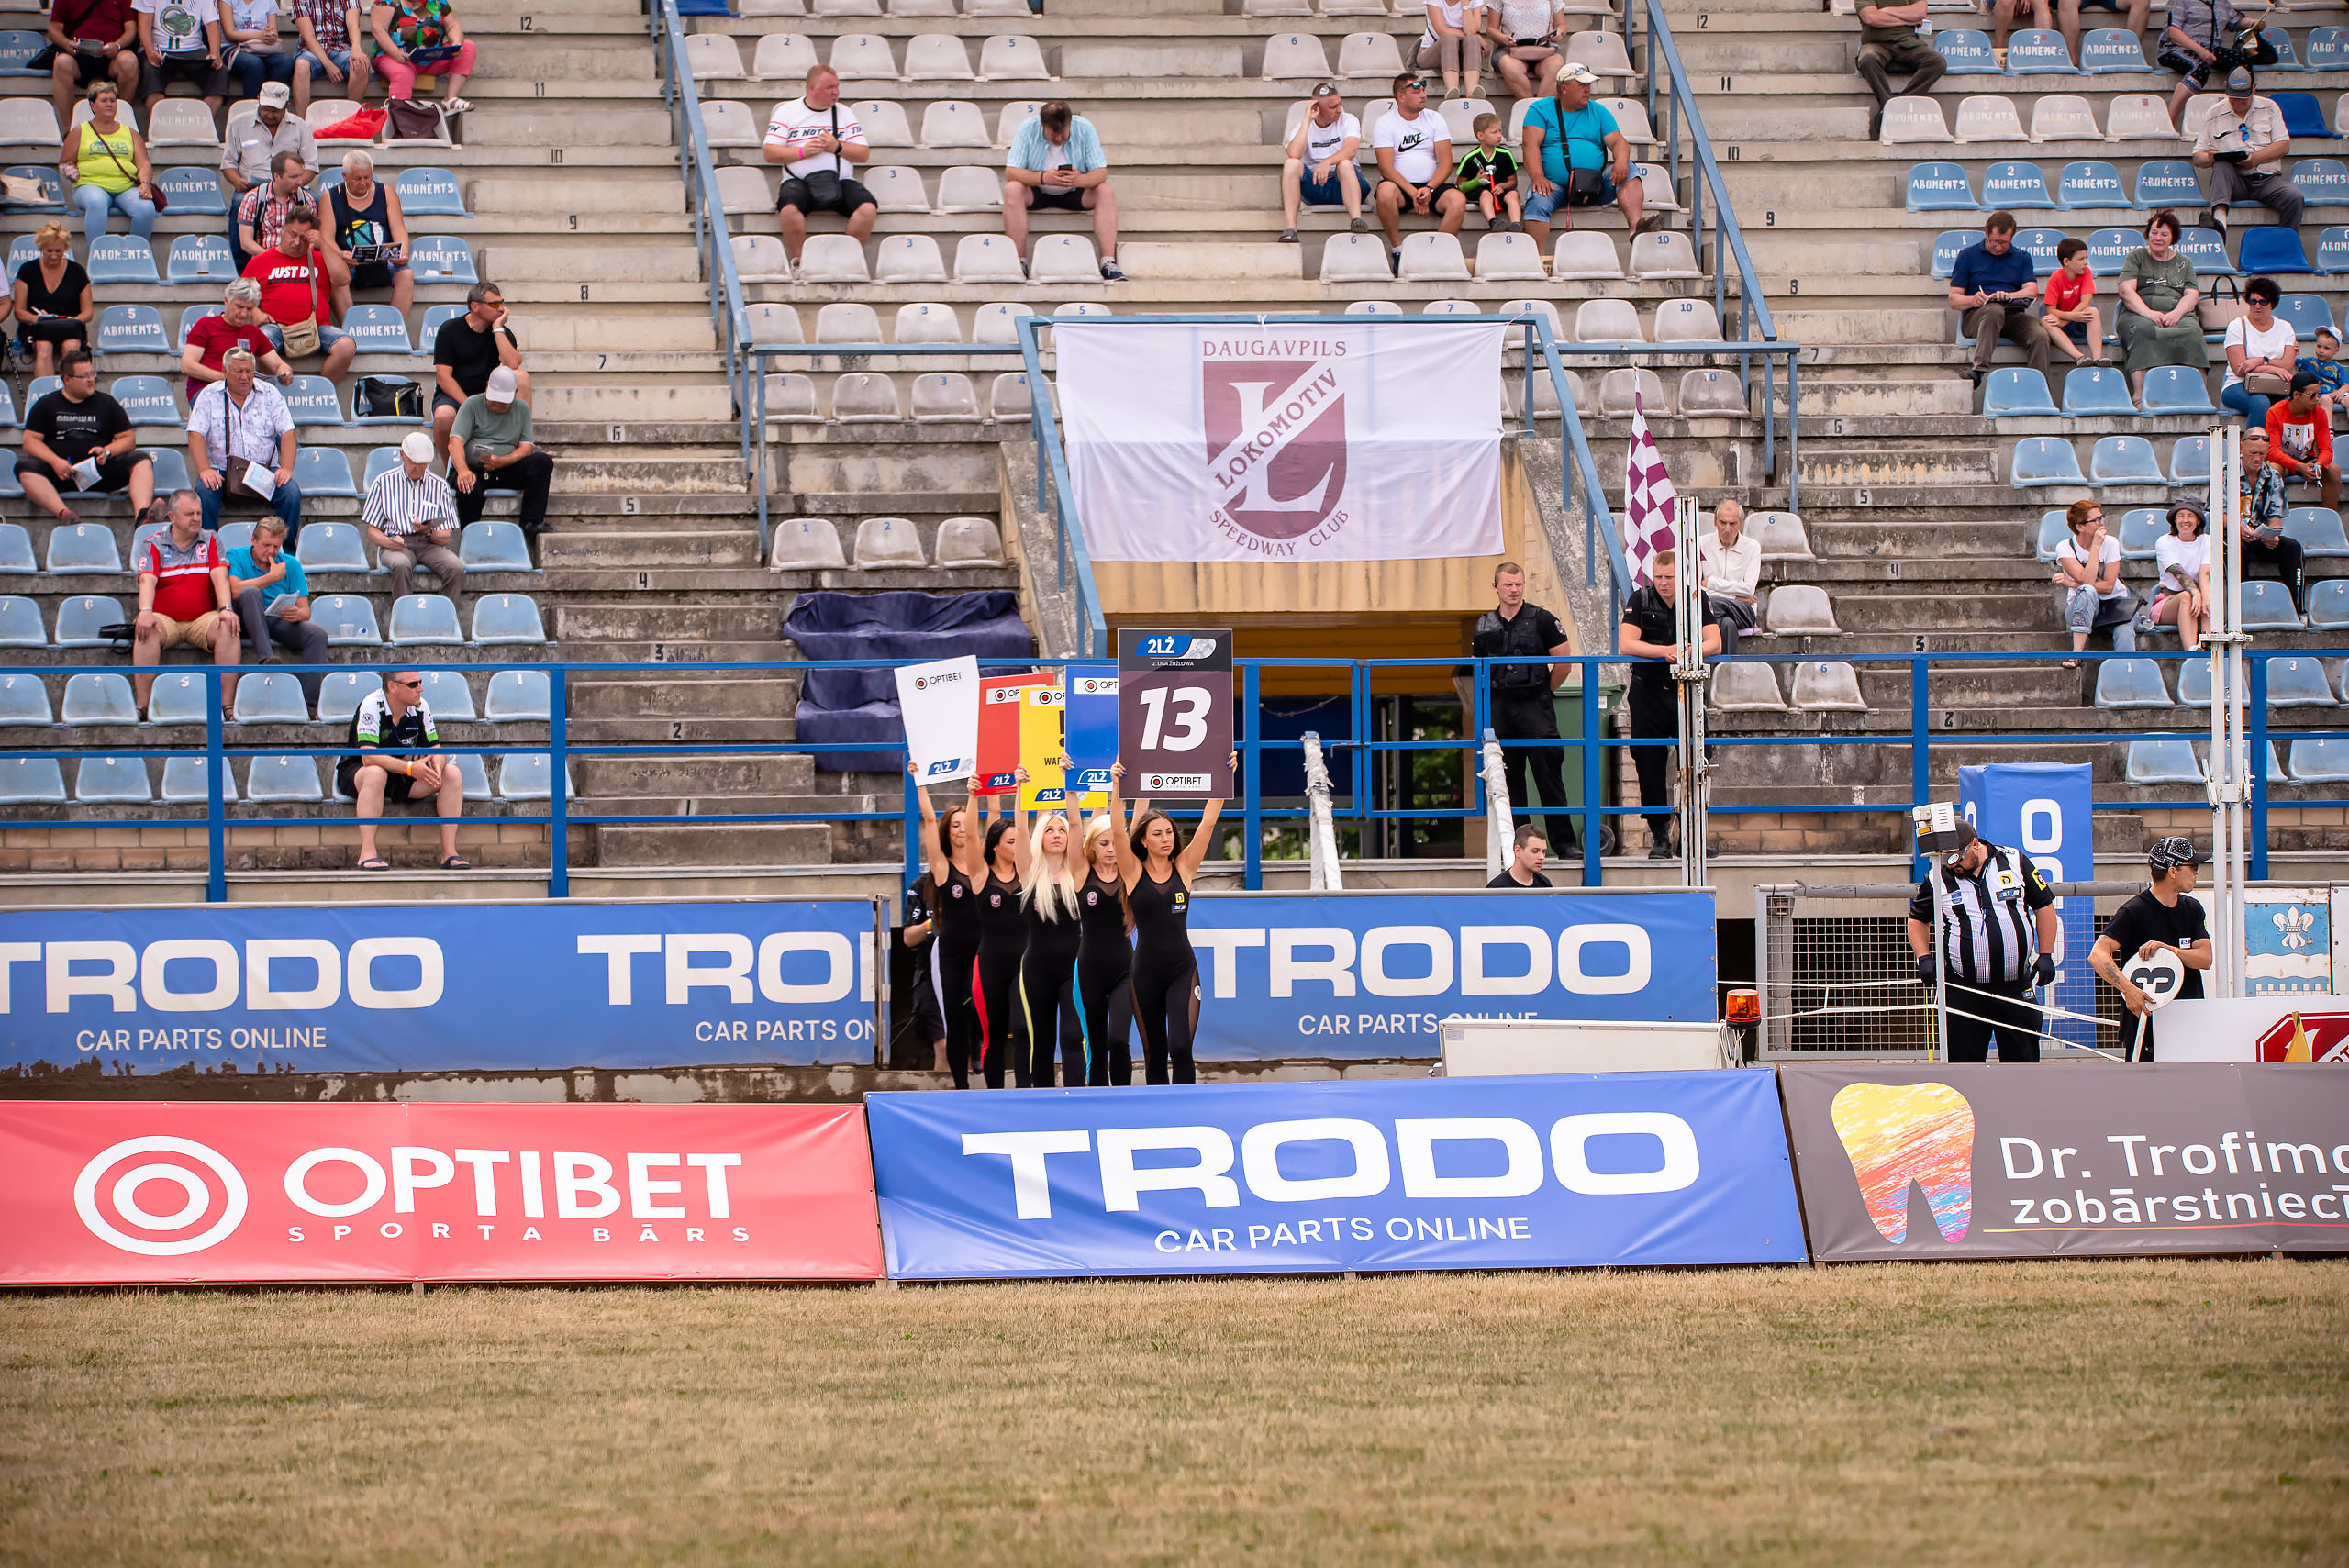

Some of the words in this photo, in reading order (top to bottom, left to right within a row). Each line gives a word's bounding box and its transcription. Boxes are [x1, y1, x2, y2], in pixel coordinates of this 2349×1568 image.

[521, 17, 531, 30] 12
[1697, 15, 1707, 28] 12
[1957, 34, 1964, 43] 2
[2033, 35, 2040, 44] 3
[534, 82, 545, 96] 11
[1721, 77, 1731, 91] 11
[1403, 133, 1421, 144] NIKE
[551, 150, 562, 163] 10
[1728, 147, 1739, 161] 10
[1934, 167, 1938, 176] 1
[2008, 166, 2014, 176] 2
[2085, 167, 2091, 176] 3
[2164, 165, 2170, 174] 4
[1913, 180, 1965, 189] ABONENTS
[1988, 179, 2040, 189] ABONENTS
[2065, 179, 2117, 188] ABONENTS
[2142, 177, 2196, 188] ABONENTS
[2293, 175, 2346, 184] ABONENTS
[161, 181, 217, 192] ABONENTS
[400, 183, 454, 195] ABONENTS
[570, 215, 576, 229] 9
[1767, 212, 1774, 226] 9
[2036, 234, 2043, 244] 2
[2114, 234, 2121, 244] 3
[2188, 232, 2195, 241] 4
[437, 240, 441, 250] 1
[173, 250, 230, 261] ABONENTS
[411, 251, 467, 261] ABONENTS
[268, 266, 299, 279] JUST
[580, 285, 588, 301] 8
[1790, 279, 1798, 295] 8
[2295, 301, 2301, 310] 5
[128, 307, 136, 318] 5
[369, 308, 376, 318] 2
[450, 308, 454, 318] 1
[103, 324, 161, 336] ABONENTS
[348, 325, 404, 337] ABONENTS
[1203, 340, 1347, 357] DAUGAVPILS
[1811, 348, 1819, 361] 7
[599, 355, 606, 369] 7
[2014, 373, 2017, 382] 1
[2093, 372, 2099, 381] 2
[2170, 370, 2176, 380] 3
[300, 380, 306, 390] 3
[613, 426, 620, 440] 6
[1214, 367, 1338, 490] LOKOMOTIV
[1834, 420, 1842, 434] 6
[2041, 441, 2045, 451] 1
[2118, 440, 2125, 450] 2
[2197, 439, 2203, 450] 3
[1861, 489, 1867, 504] 5
[627, 497, 634, 512] 5
[2147, 514, 2154, 524] 2
[326, 526, 333, 537] 3
[488, 525, 492, 536] 1
[1208, 509, 1296, 557] SPEEDWAY
[1309, 509, 1350, 547] CLUB
[1890, 564, 1898, 577] 4
[640, 573, 647, 588] 4
[2256, 584, 2264, 595] 3
[335, 598, 342, 607] 3
[418, 597, 426, 608] 2
[1147, 636, 1174, 654] 2LŻ
[1915, 636, 1925, 652] 3
[656, 644, 664, 660] 3
[2128, 662, 2132, 673] 1
[2290, 661, 2297, 671] 3
[181, 676, 189, 688] 5
[349, 674, 356, 684] 3
[929, 672, 962, 684] OPTIBET
[1140, 686, 1212, 751] 13
[1945, 712, 1954, 727] 2
[674, 723, 681, 738] 2
[933, 761, 951, 774] 2LŻ
[994, 774, 1010, 785] 2LŻ
[1087, 771, 1107, 783] 2LŻ
[1166, 776, 1201, 785] OPTIBET
[1042, 789, 1061, 800] 2LŻ
[686, 800, 690, 815] 1
[1187, 923, 1652, 999] TRODO
[2131, 967, 2175, 993] 3
[696, 1020, 749, 1042] CAR
[755, 1019, 838, 1041] PARTS
[1298, 1014, 1352, 1036] CAR
[1358, 1013, 1438, 1034] PARTS
[76, 1029, 132, 1051] CAR
[139, 1028, 222, 1051] PARTS
[230, 1026, 327, 1050] ONLINE
[1998, 1136, 2092, 1180] Dr.
[963, 1112, 1700, 1220] TRODO
[284, 1147, 742, 1220] OPTIBET
[288, 1222, 544, 1242] SPORTA
[594, 1222, 751, 1242] BĀRS
[1153, 1227, 1238, 1255] CAR
[1248, 1217, 1374, 1249] PARTS
[1386, 1216, 1532, 1243] ONLINE
